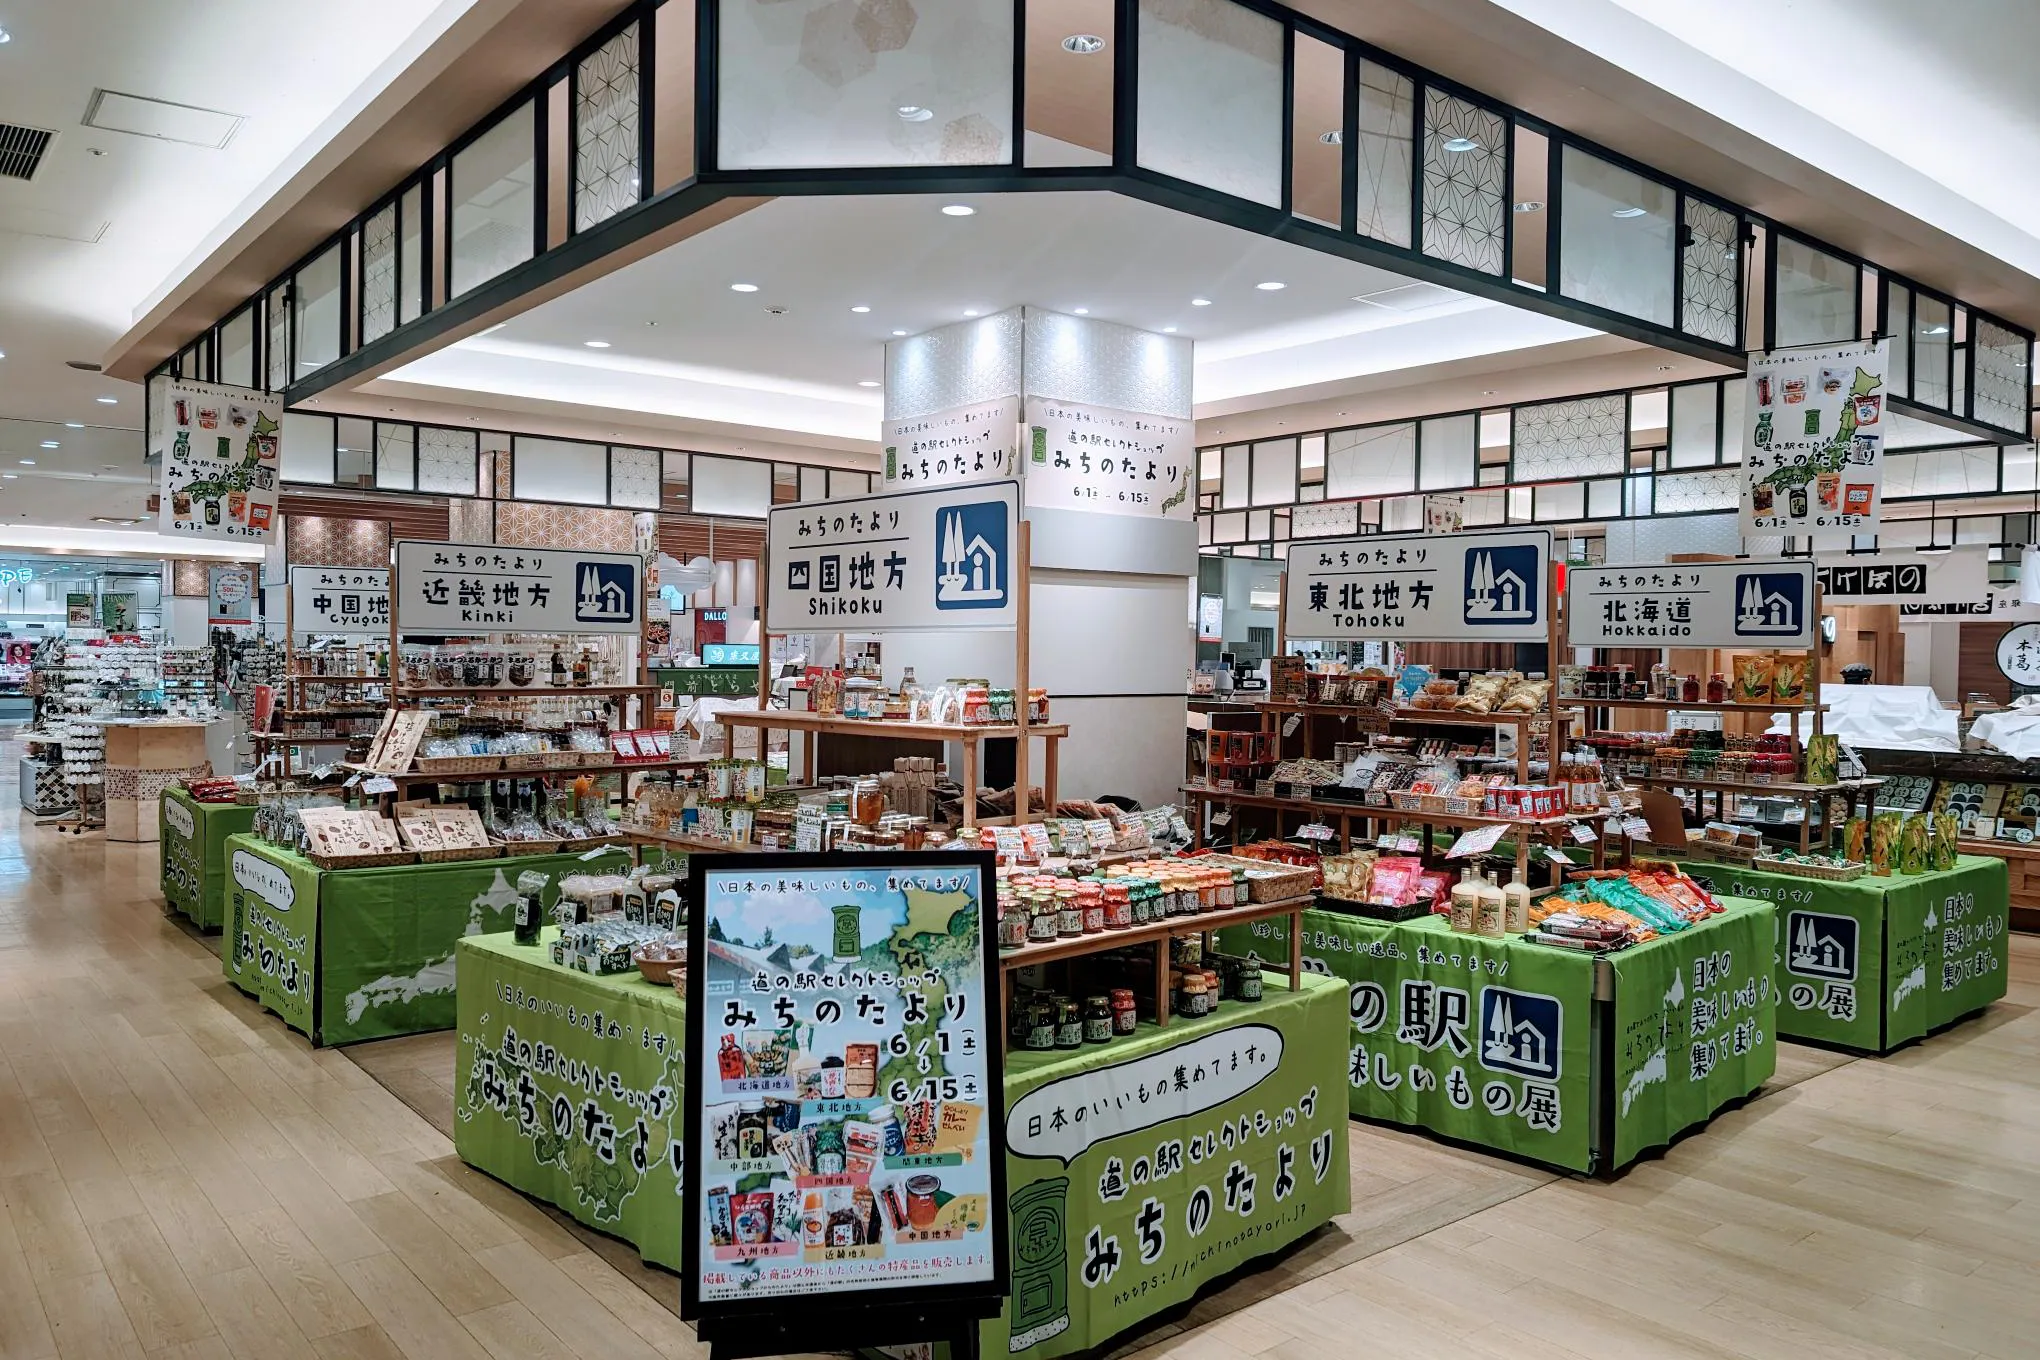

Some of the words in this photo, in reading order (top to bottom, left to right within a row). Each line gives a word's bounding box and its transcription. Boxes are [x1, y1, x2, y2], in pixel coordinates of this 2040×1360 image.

[902, 449, 1002, 481] みちのたより
[1054, 450, 1177, 483] みちのたより
[1749, 450, 1875, 468] みちのたより
[169, 466, 274, 490] みちのたより
[798, 509, 901, 537] みちのたより
[434, 551, 544, 571] みちのたより
[1318, 549, 1429, 566] みちのたより
[788, 550, 908, 593] 四国地方
[1599, 574, 1702, 588] みちのたより
[423, 578, 551, 608] 近畿地方
[1309, 580, 1434, 612] 東北地方
[462, 609, 514, 623] Kinki
[808, 597, 883, 617] Shikoku
[1604, 597, 1693, 624] 北海道
[1332, 613, 1406, 628] Tohoku
[1602, 624, 1692, 637] Hokkaido
[1944, 892, 1974, 923] 日本の
[752, 970, 940, 992] 道の駅セレクトショップ
[1694, 952, 1730, 991] 日本の
[724, 993, 966, 1028] みちのたより
[502, 1026, 668, 1116] 道の駅セレクトショップ
[738, 1082, 790, 1091] 北海道地方
[1028, 1045, 1266, 1138] 日本のいいもの集めてます。
[816, 1102, 862, 1113] 東北地方
[1101, 1087, 1318, 1199] 道の駅セレクトショップ
[730, 1161, 772, 1171] 中部地方
[902, 1157, 943, 1166] 関東地方
[814, 1176, 852, 1185] 四国地方
[1083, 1132, 1331, 1286] みちのたより
[909, 1230, 951, 1241] 中国地方
[737, 1247, 778, 1257] 九州地方
[825, 1250, 866, 1260] 近畿地方
